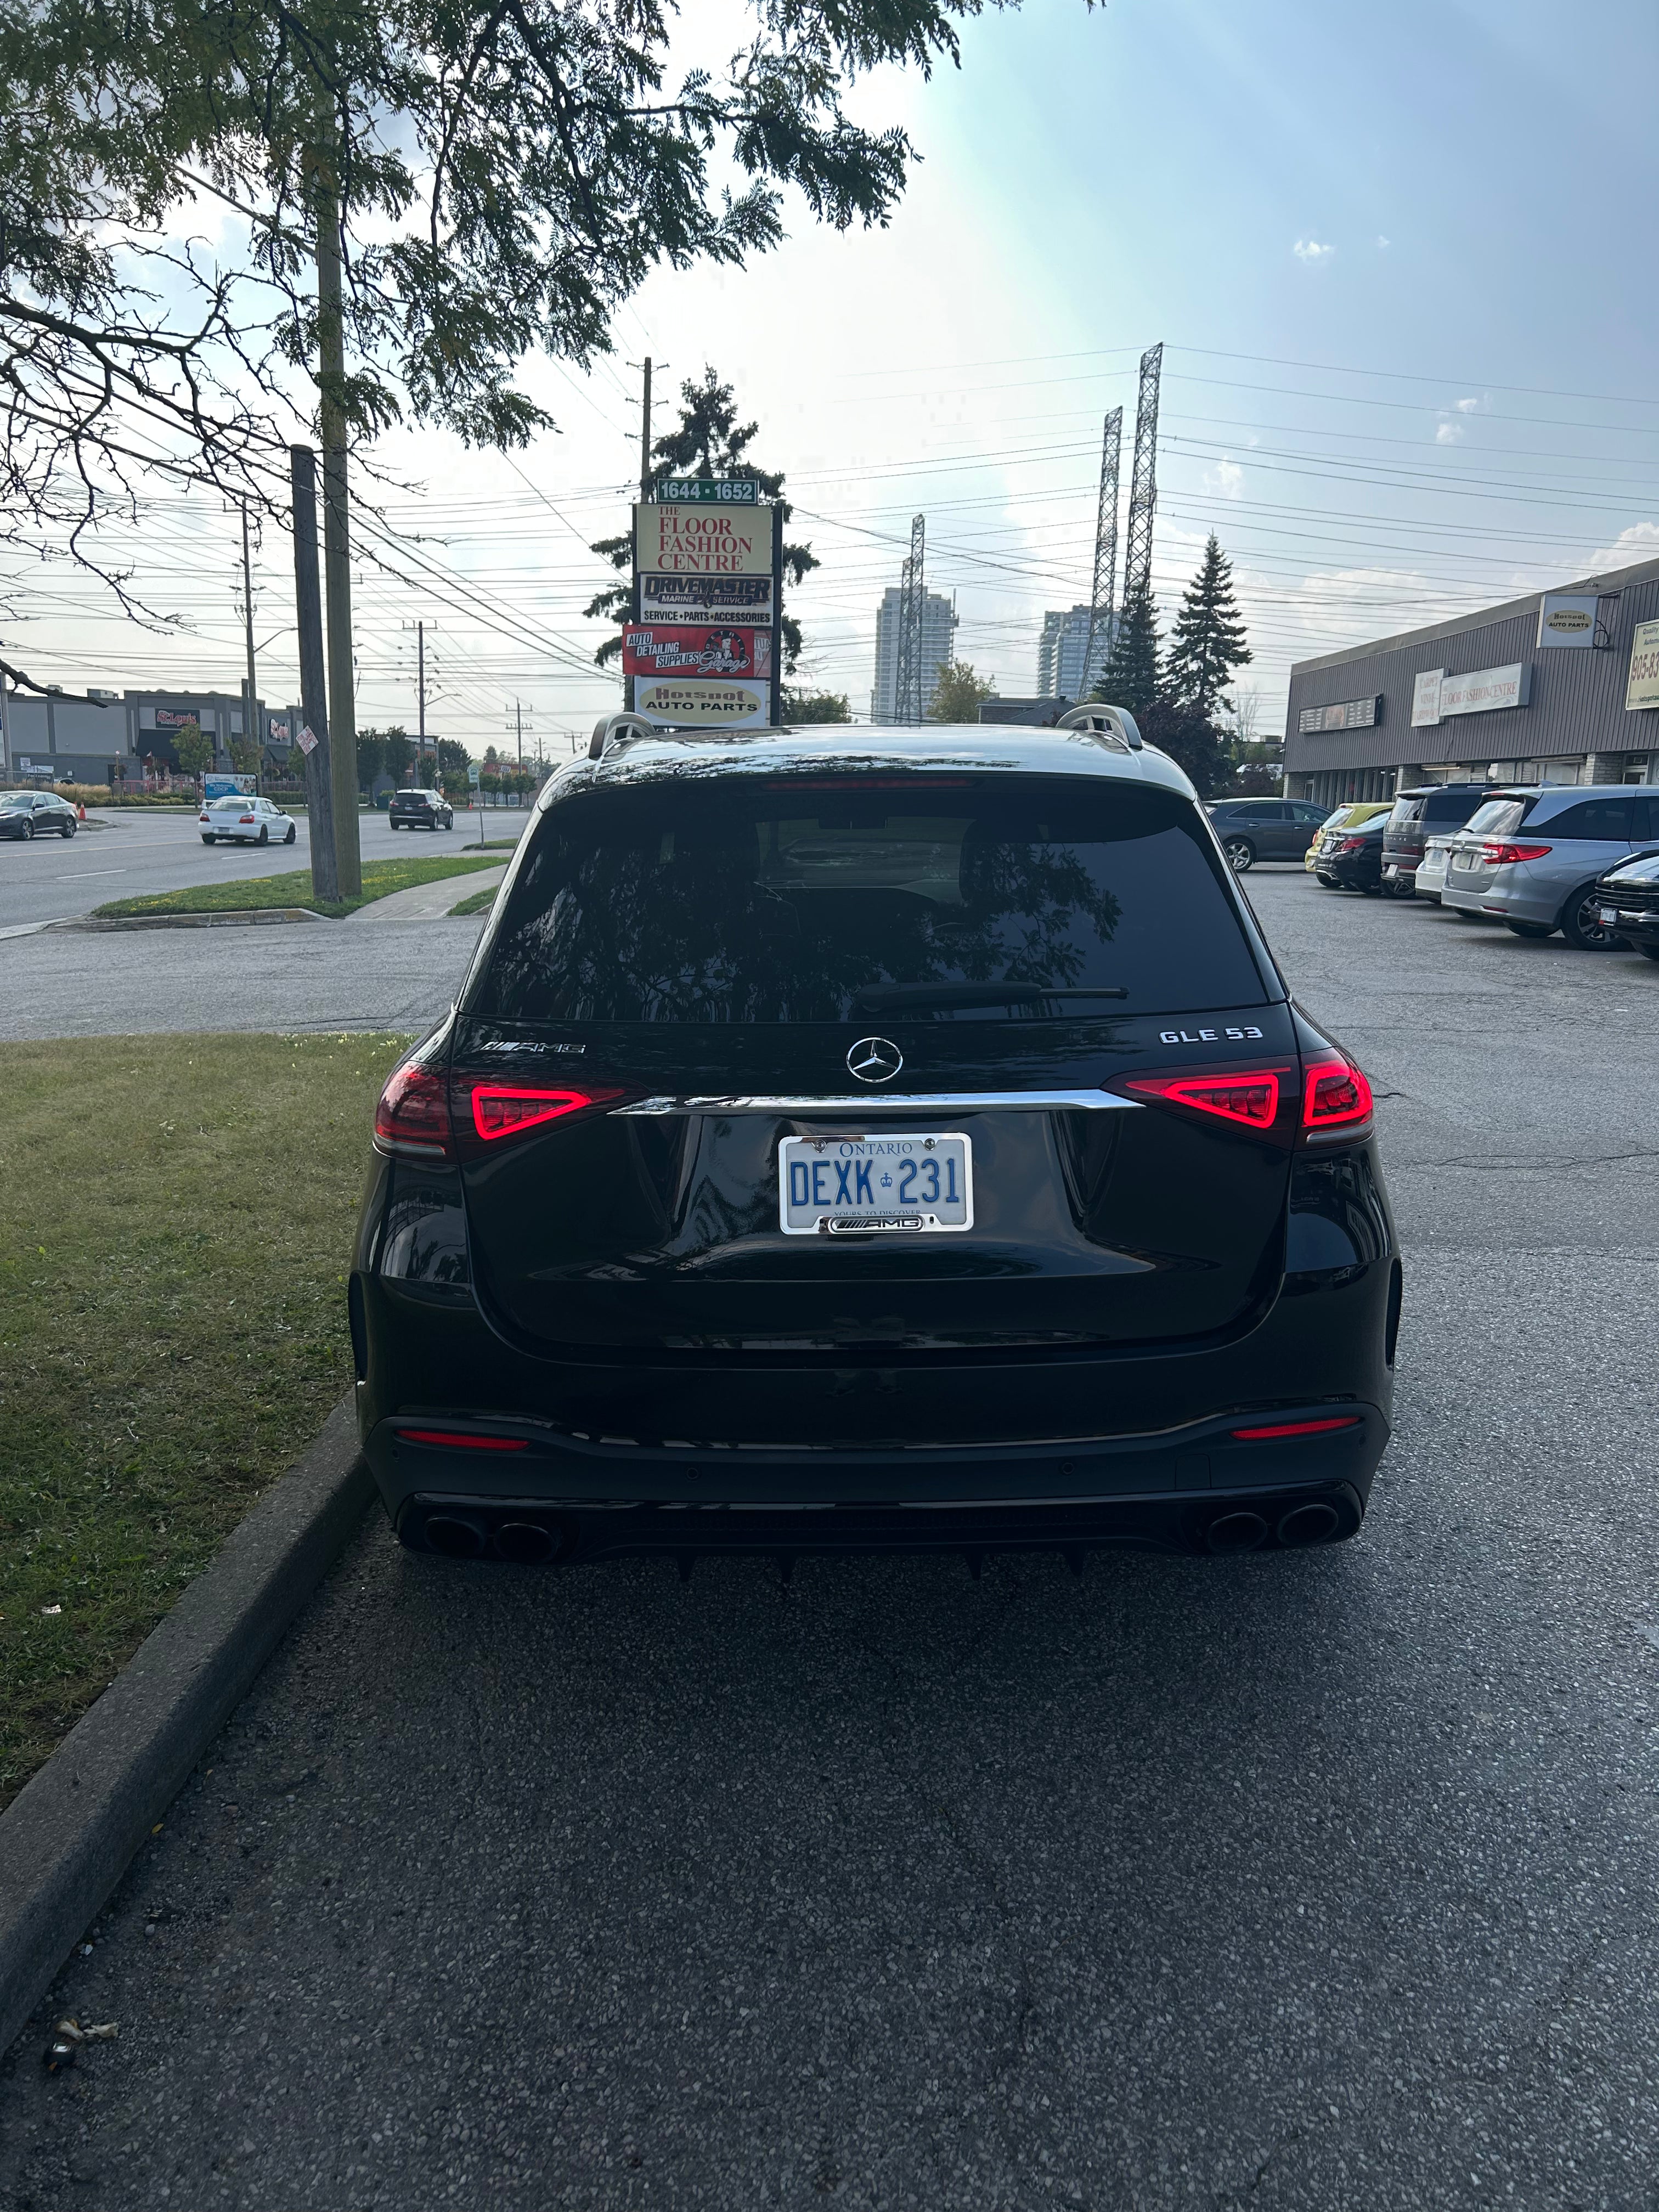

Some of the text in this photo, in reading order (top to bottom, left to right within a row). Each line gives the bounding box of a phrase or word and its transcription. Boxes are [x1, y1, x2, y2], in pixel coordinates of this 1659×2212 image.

[662, 482, 752, 500] 1644 1652
[658, 506, 680, 515] THE
[659, 517, 733, 535] FLOOR
[659, 535, 752, 554] FASHION
[658, 554, 743, 571] CENTRE
[645, 577, 770, 599] DRIVEMASTER
[644, 611, 770, 623] SERVICE PARTS ACCESSORIES
[628, 634, 651, 645] AUTO
[636, 642, 679, 656] DETAILING
[658, 653, 698, 667] SUPPLIES
[697, 651, 751, 673] Garage
[1441, 681, 1517, 706] FLOOR FASHION CENTRE
[646, 702, 758, 712] AUTO PARTS
[1159, 1026, 1263, 1044] GLE 53
[514, 1042, 586, 1053] AMG
[839, 1143, 912, 1157] ONTARIO
[790, 1158, 959, 1206] DEXK 231
[863, 1218, 919, 1228] AMG
